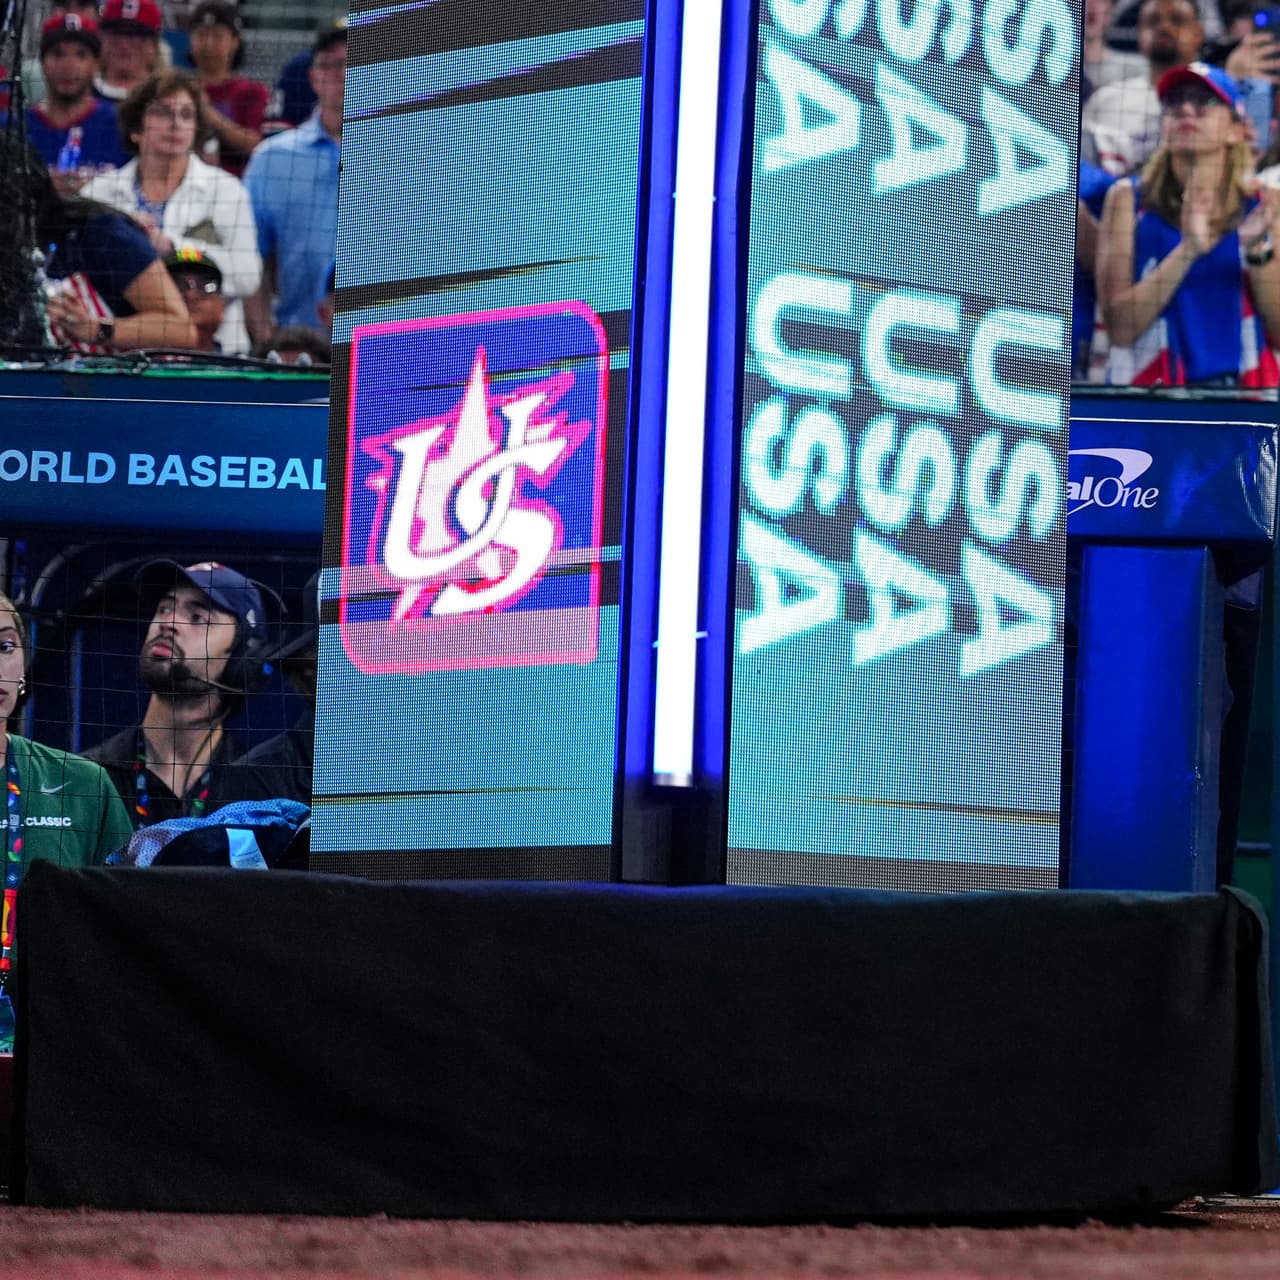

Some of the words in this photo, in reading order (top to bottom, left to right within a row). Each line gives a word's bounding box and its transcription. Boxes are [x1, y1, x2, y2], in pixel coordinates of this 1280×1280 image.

[0, 449, 116, 484] ORLD
[127, 453, 327, 490] BASEBAL
[738, 268, 855, 656] USA
[851, 289, 962, 667] USA
[958, 307, 1064, 678] USA
[25, 816, 72, 827] CLASSIC
